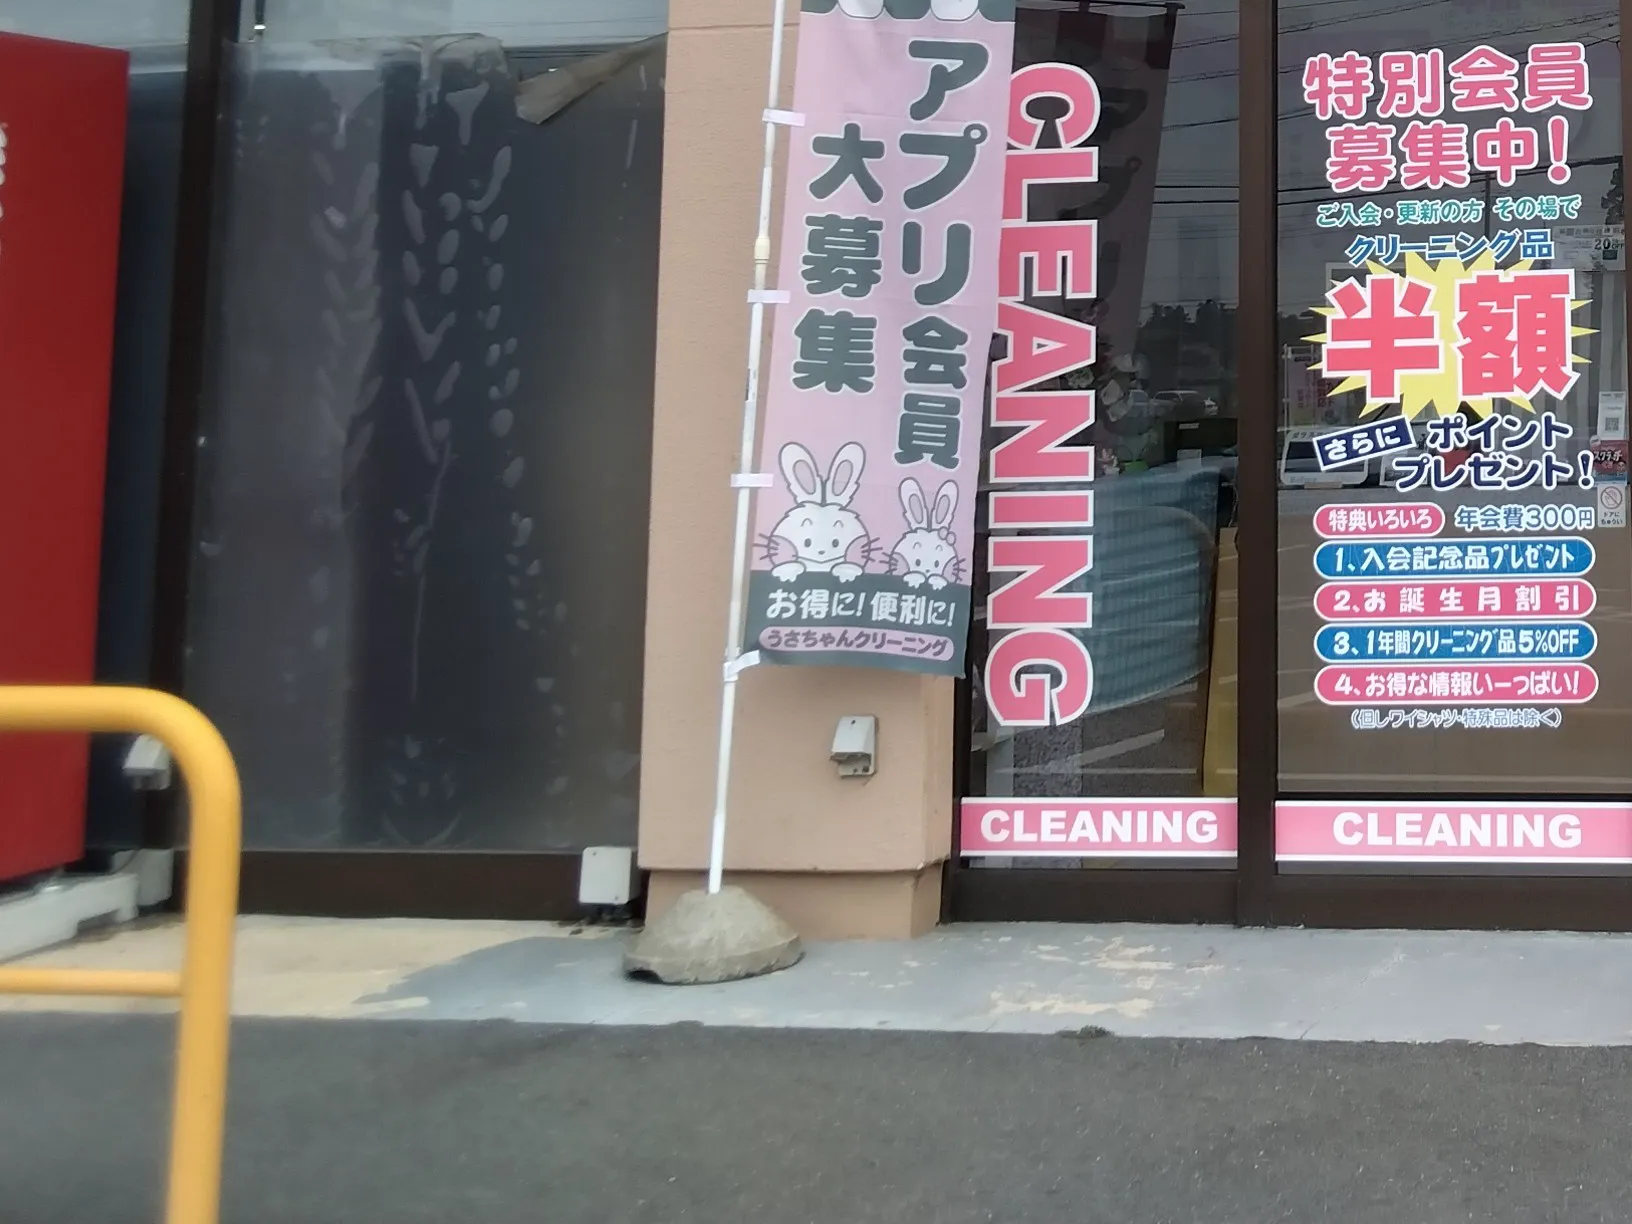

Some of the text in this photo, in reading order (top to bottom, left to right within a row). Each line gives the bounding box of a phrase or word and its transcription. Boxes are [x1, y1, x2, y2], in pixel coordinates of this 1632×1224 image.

[1304, 43, 1592, 119] 特別会員
[1326, 117, 1572, 192] 募集中!
[1316, 195, 1582, 227] ご入会・更新の方 その場で
[791, 122, 884, 393] 大募集
[892, 40, 989, 469] アプリ会員
[1346, 229, 1554, 265] クリーニング品
[1324, 269, 1577, 401] 半額
[984, 62, 1101, 727] CLEANING
[1323, 422, 1402, 462] さらに
[1428, 413, 1573, 451] ポイント
[1396, 453, 1596, 492] プレゼント!
[1328, 505, 1595, 532] 特典いろいろ 年会費300円
[765, 588, 956, 627] お得に! 便利に!
[767, 629, 948, 657] うさちゃんクリーニング
[981, 809, 1219, 845] CLEANING
[1332, 812, 1583, 849] CLEANING
